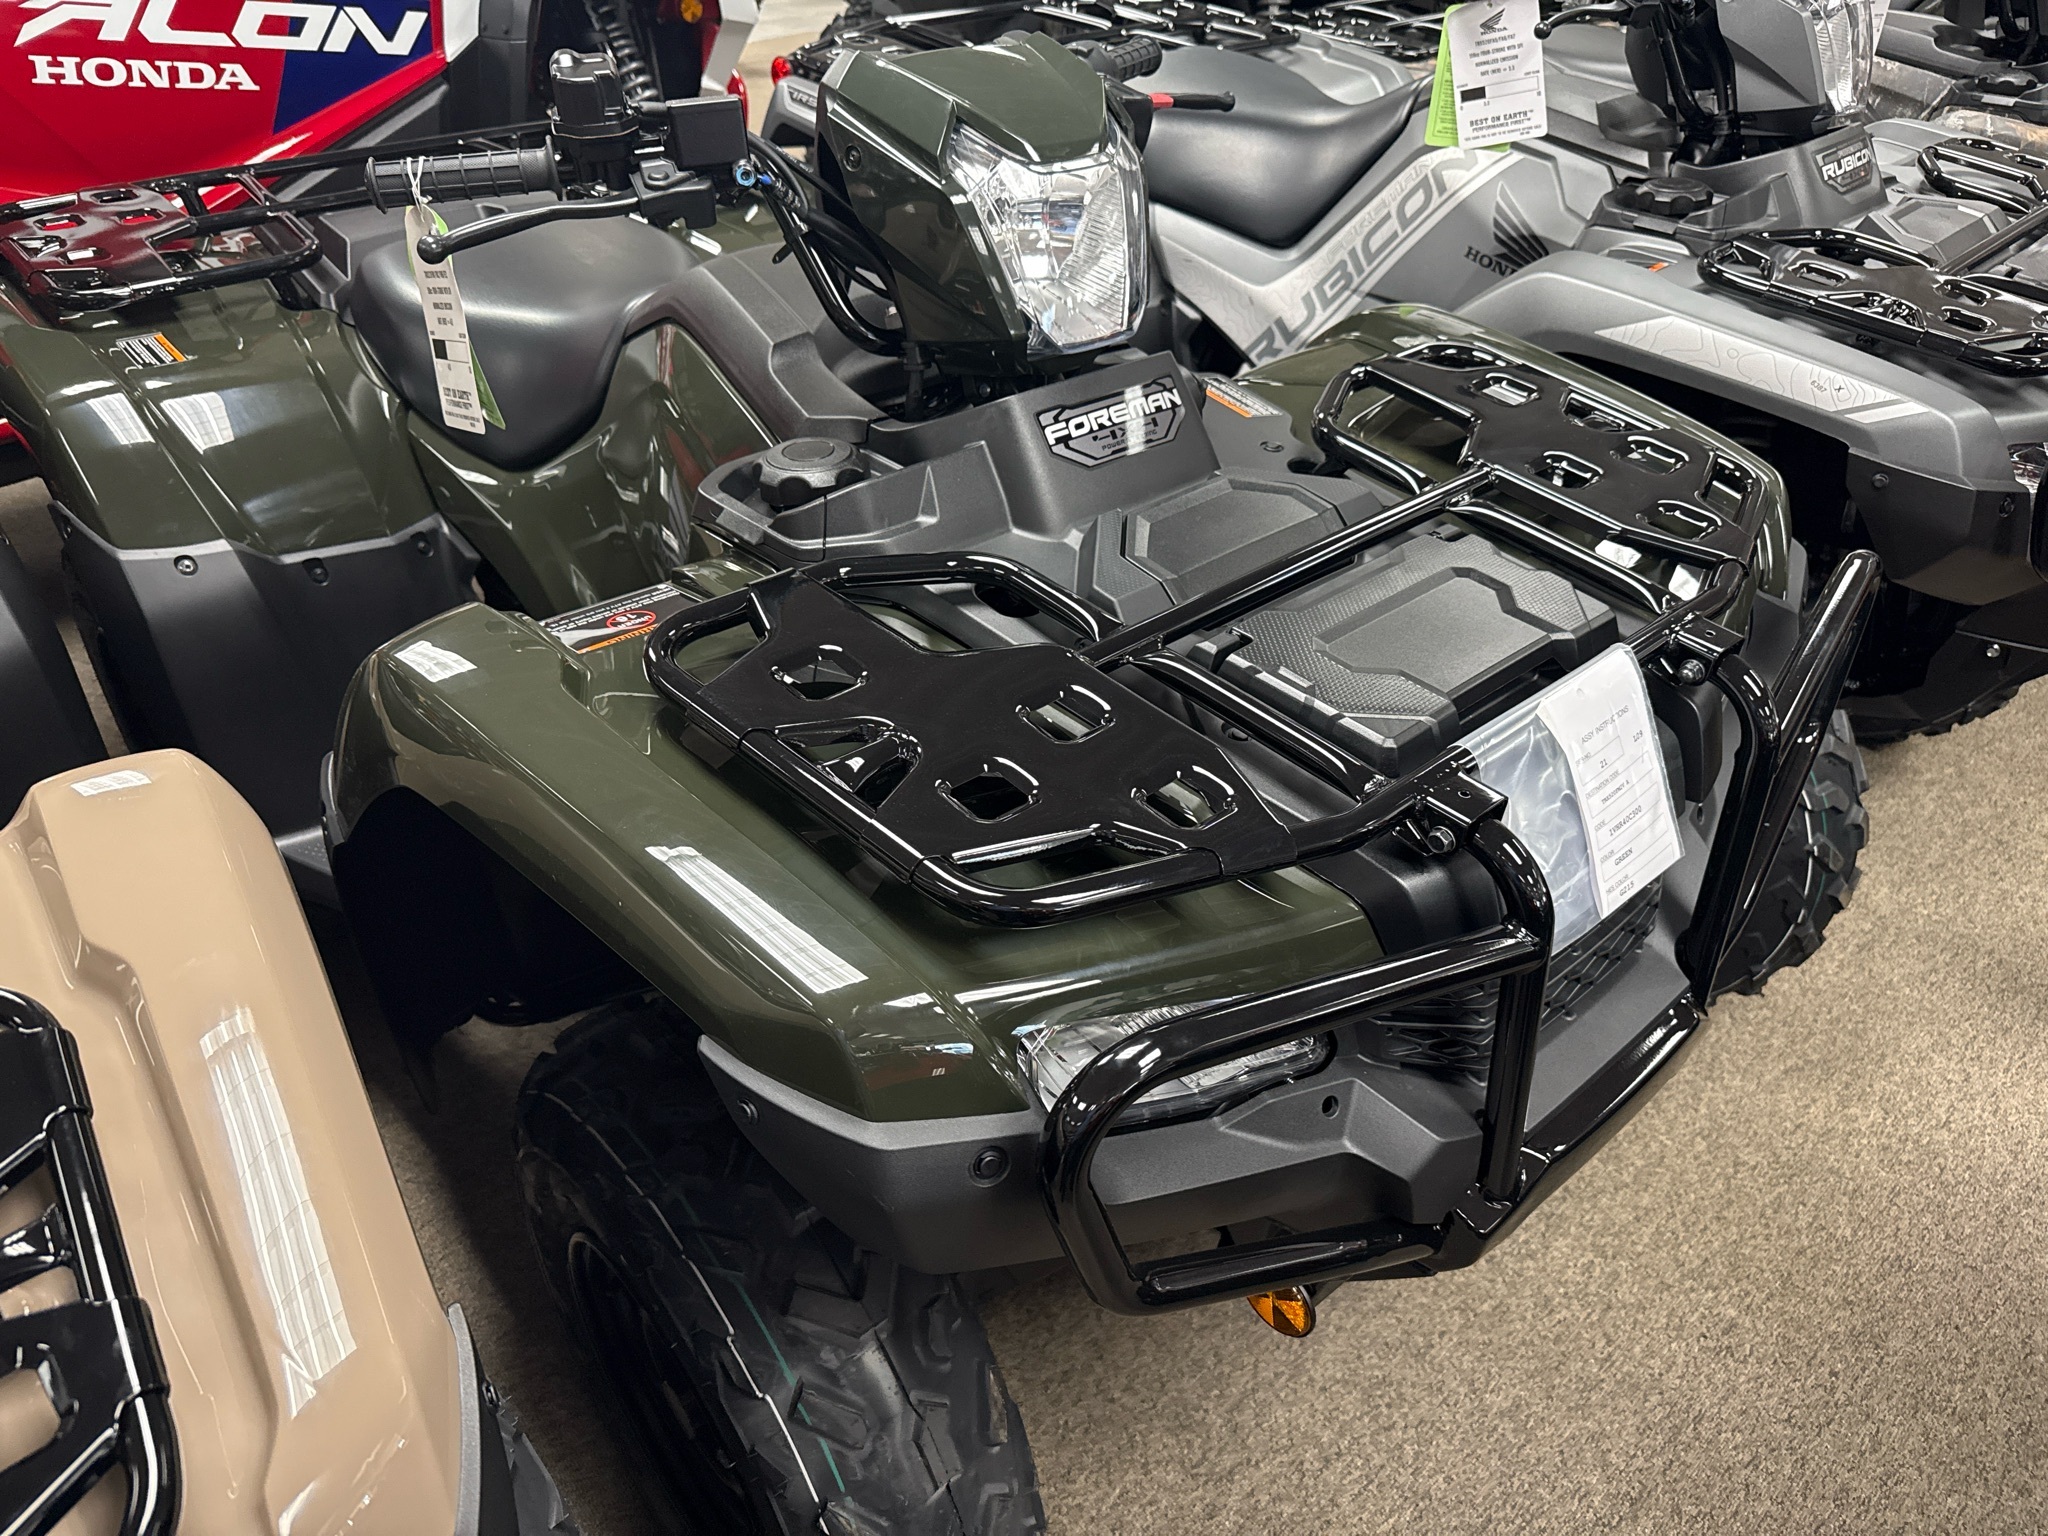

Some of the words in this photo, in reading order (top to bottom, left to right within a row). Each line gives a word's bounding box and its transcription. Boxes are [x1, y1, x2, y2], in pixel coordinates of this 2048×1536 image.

[1480, 26, 1508, 36] HONDA
[28, 54, 260, 91] HONDA
[1469, 118, 1489, 128] BEST
[1490, 115, 1501, 123] ON
[1472, 121, 1509, 133] PERFORMANCE
[1244, 148, 1478, 362] RUBICON
[1044, 388, 1182, 446] FOREMAN
[1101, 438, 1126, 450] POWER
[615, 614, 637, 622] 16
[616, 615, 652, 628] UNDER
[1581, 730, 1594, 744] ASSY
[1600, 758, 1607, 768] 21
[1585, 778, 1609, 799] DESTINATION
[1609, 769, 1620, 781] CODE
[1594, 820, 1606, 832] CODE
[1600, 849, 1614, 863] COLOR
[1614, 847, 1633, 865] GREEN
